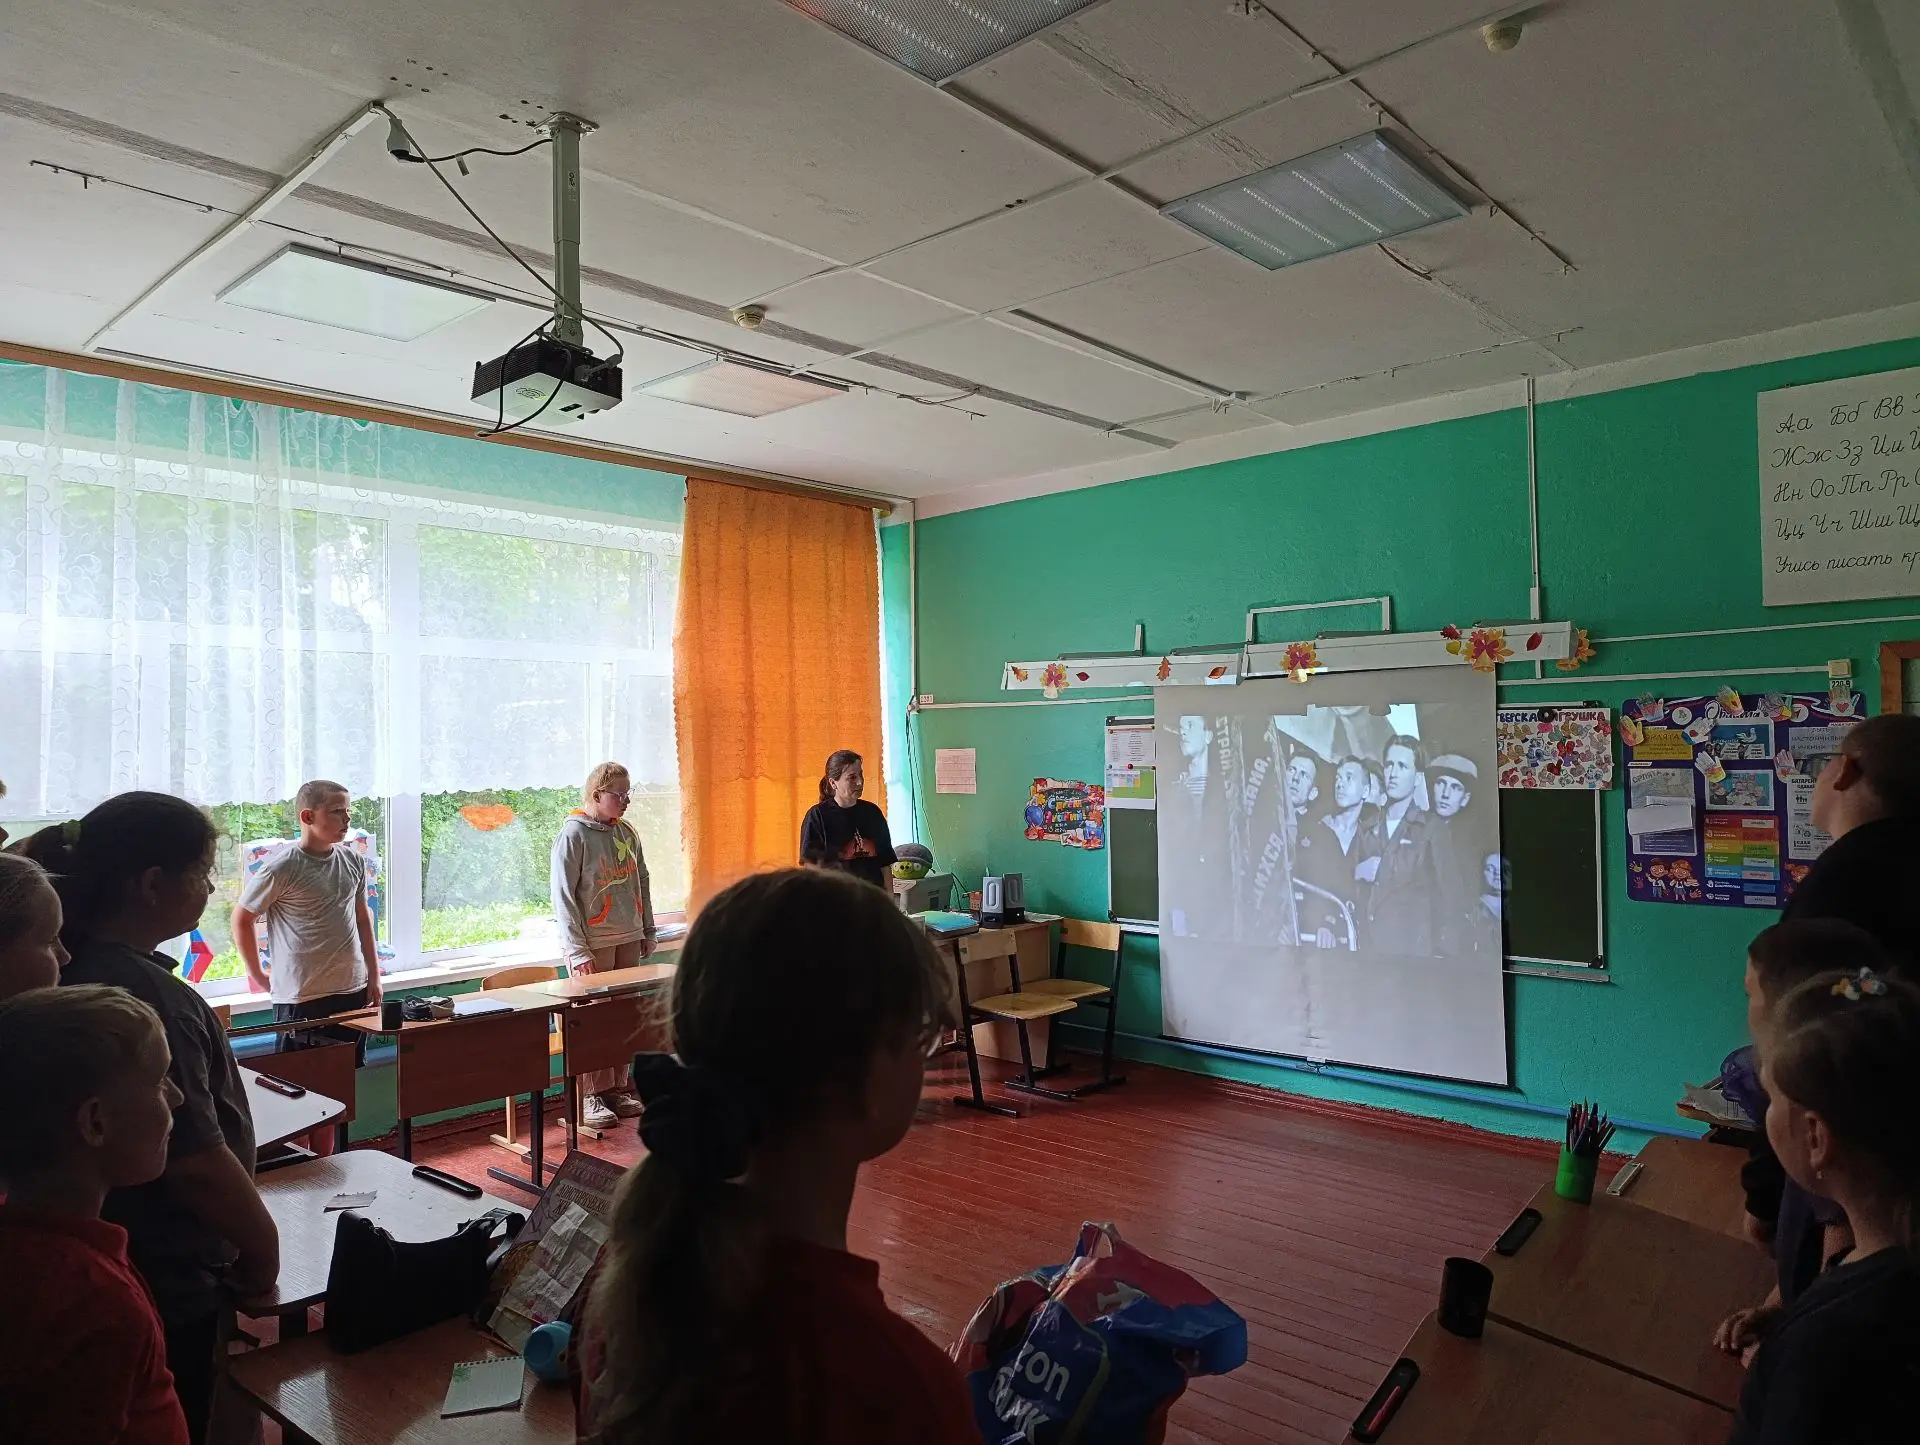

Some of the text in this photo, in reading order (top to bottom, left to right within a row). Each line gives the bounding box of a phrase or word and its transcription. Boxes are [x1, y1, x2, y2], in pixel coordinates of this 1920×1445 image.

[1775, 413, 1814, 434] Аа
[1830, 400, 1868, 426] Бб
[1873, 395, 1904, 420] Вв
[1770, 445, 1832, 468] Жж
[1835, 439, 1863, 467] Зз
[1870, 434, 1905, 455] Ии
[1773, 482, 1804, 503] Нн
[1810, 478, 1835, 498] Оо
[1837, 473, 1874, 496] Пп
[1878, 469, 1910, 498] Рр
[1774, 517, 1806, 541] Цц
[1809, 513, 1844, 534] Чч
[1849, 508, 1894, 530] Шш
[1775, 555, 1820, 574] Учись
[1826, 554, 1893, 570] писать
[1497, 711, 1538, 723] ВЕРСКА
